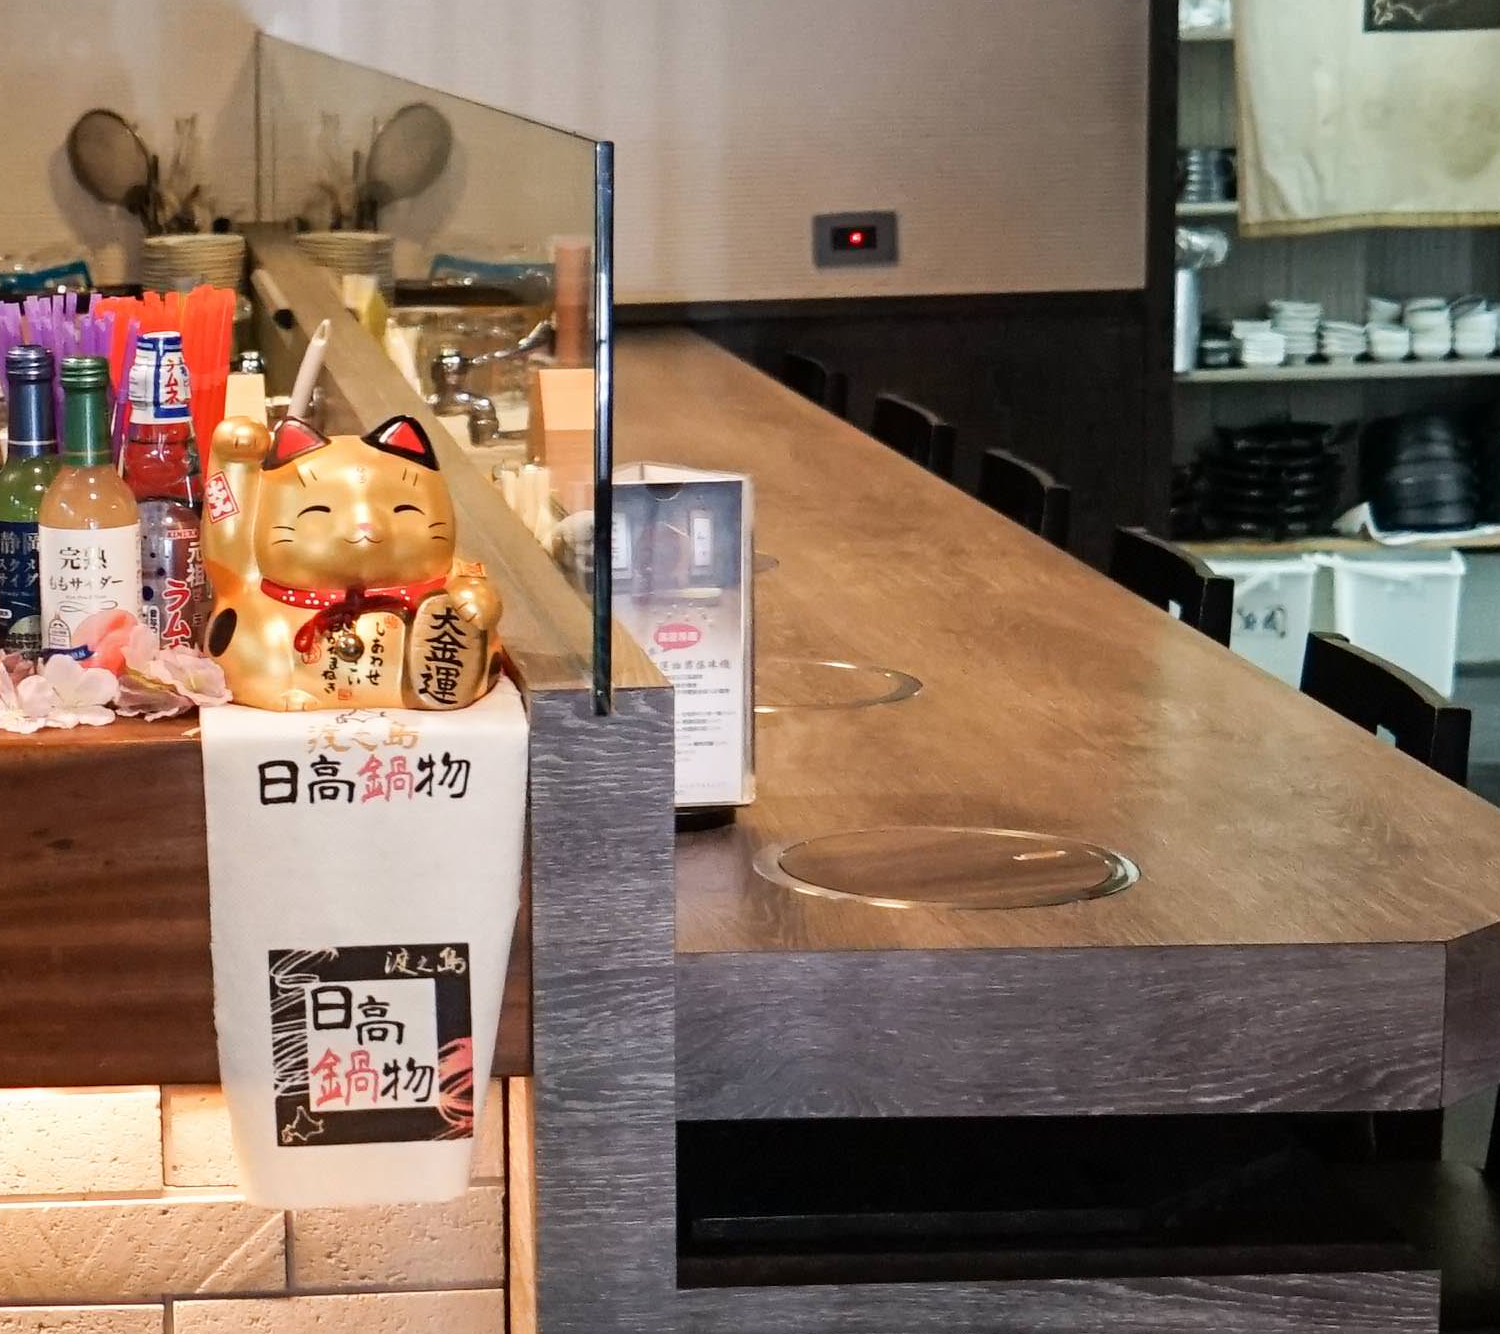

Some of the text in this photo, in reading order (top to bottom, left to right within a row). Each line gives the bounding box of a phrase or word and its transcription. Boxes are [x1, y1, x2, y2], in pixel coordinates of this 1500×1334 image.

[165, 358, 179, 405] ラムネ
[49, 575, 124, 591] ももサイダー
[186, 541, 205, 588] 元祖
[364, 621, 386, 686] しあわせ
[418, 607, 470, 704] 大金運
[258, 752, 471, 805] 日高鍋物
[384, 947, 467, 975] 渡之島
[311, 985, 405, 1045] 日高
[311, 1048, 434, 1107] 鍋物
